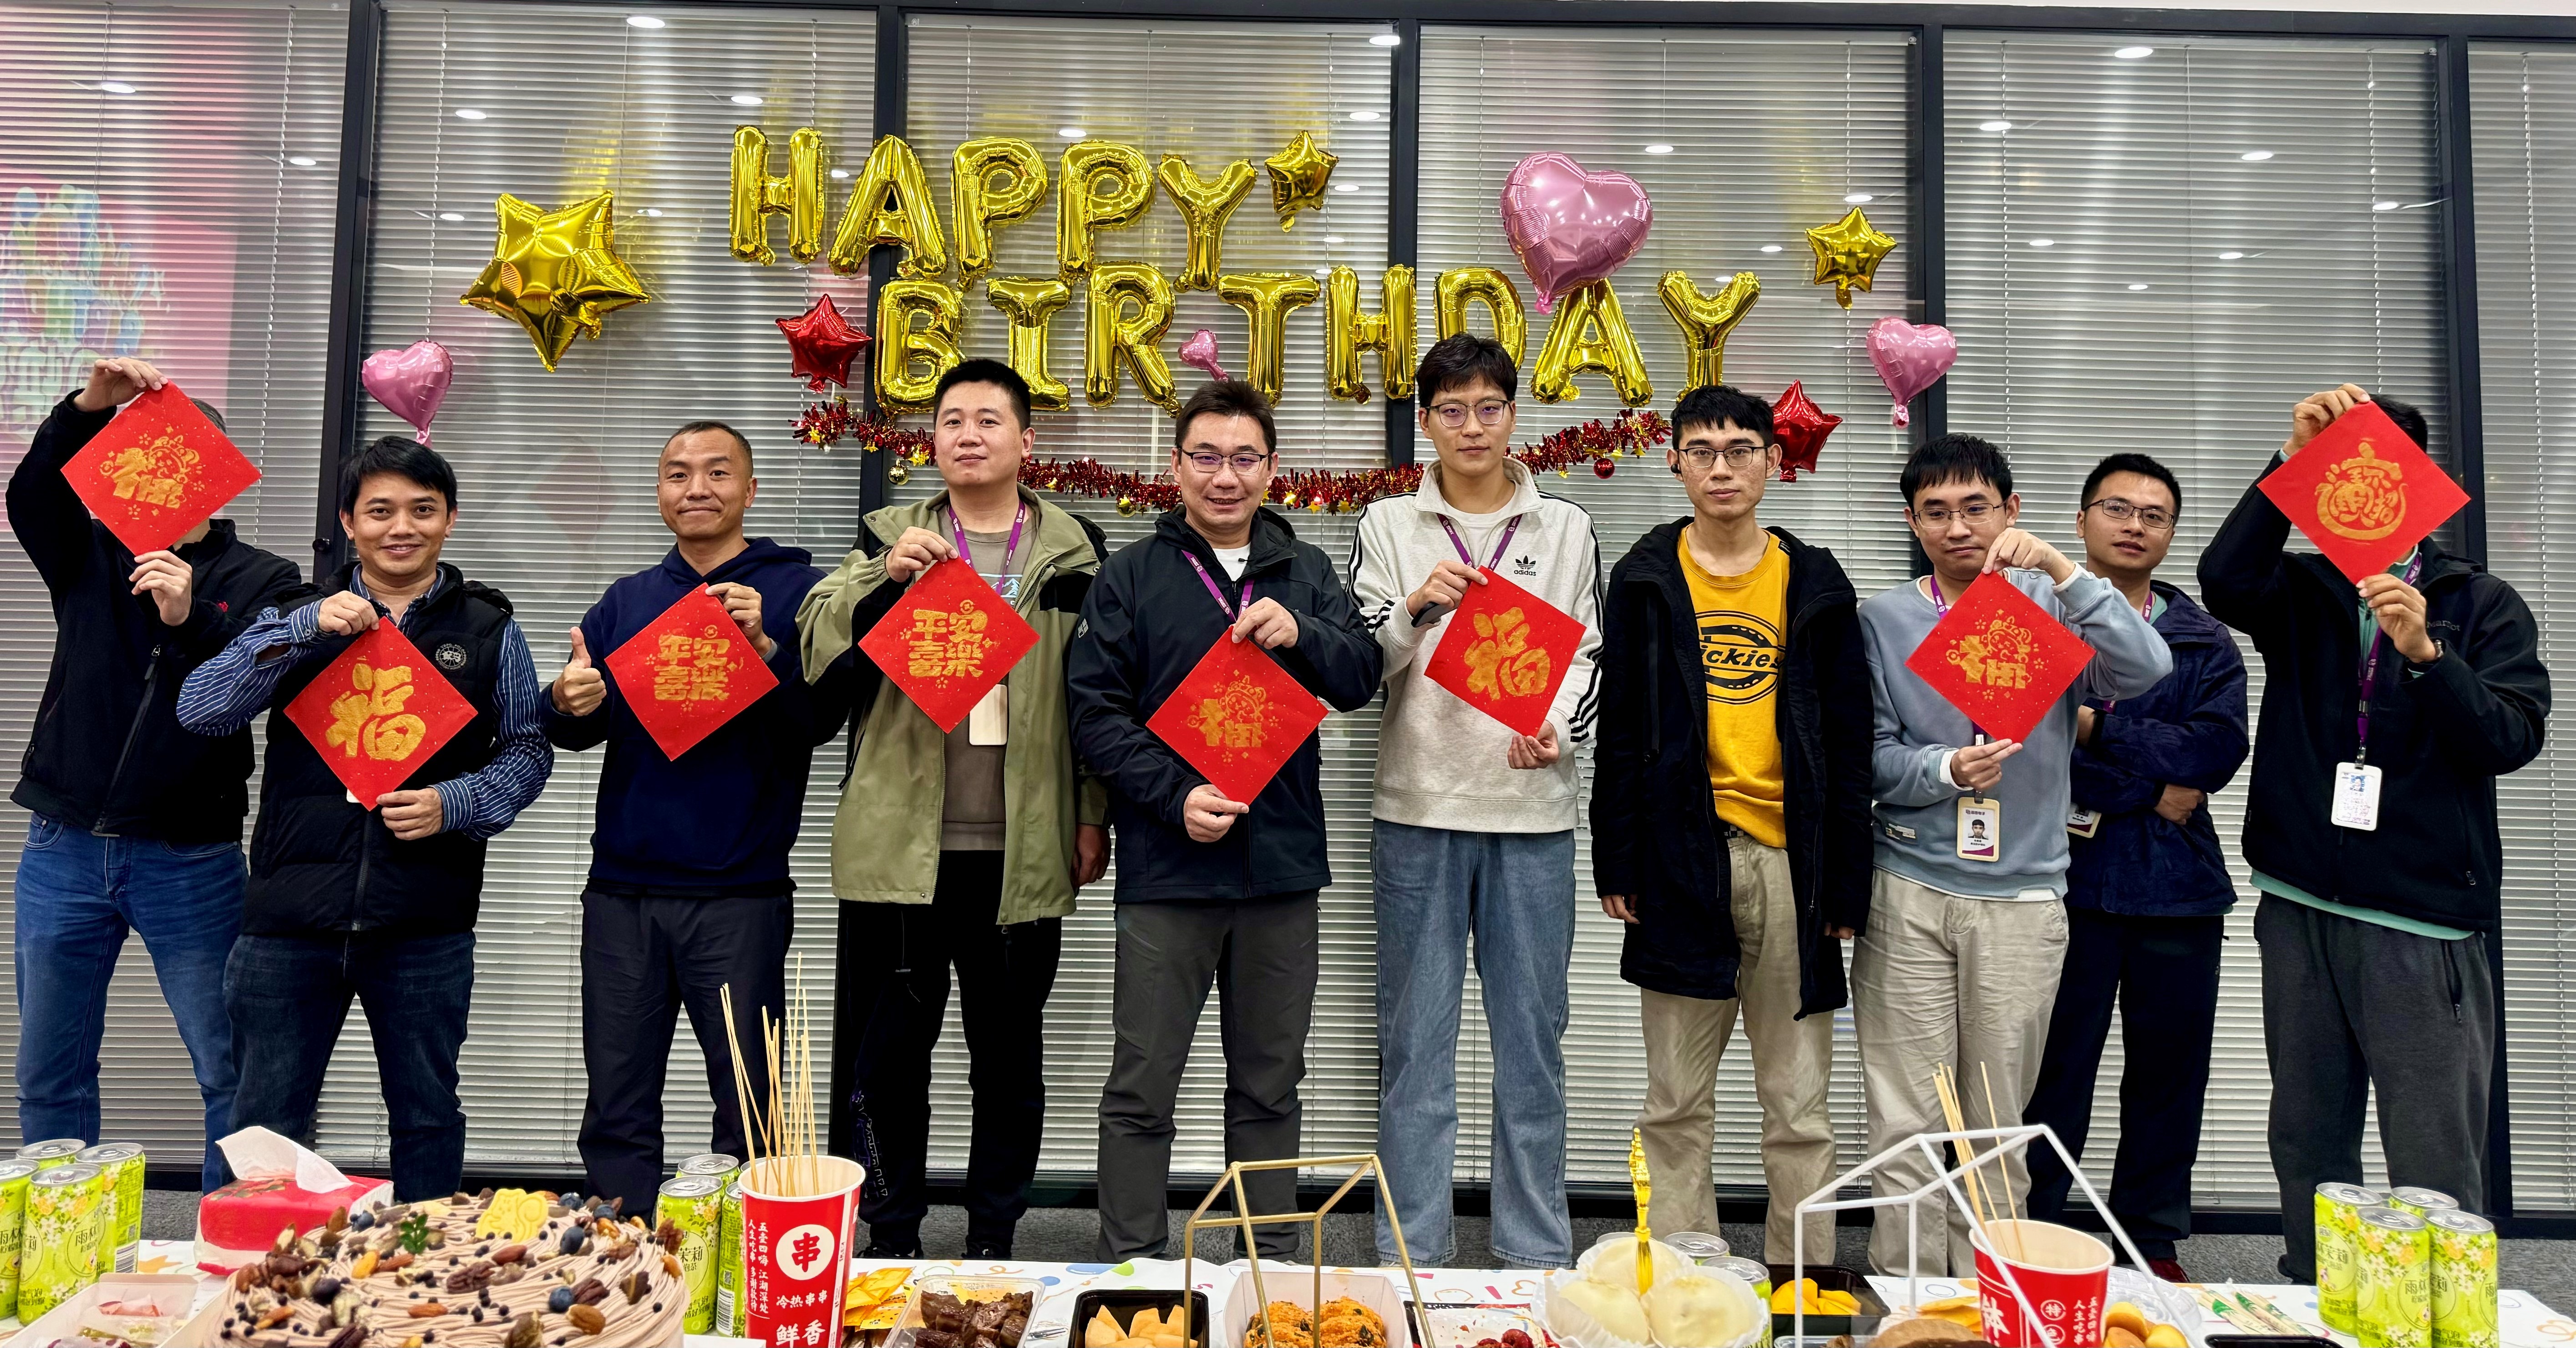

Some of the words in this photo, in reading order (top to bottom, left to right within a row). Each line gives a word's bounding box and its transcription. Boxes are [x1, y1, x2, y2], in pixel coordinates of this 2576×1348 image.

[729, 125, 1257, 290] HAPPY
[874, 261, 1760, 418] BIRTHDAY
[912, 609, 988, 643] 平安
[658, 634, 730, 667] 平安
[1464, 607, 1550, 700] 福
[1701, 645, 1779, 669] ickies
[325, 663, 426, 762] 福
[791, 1232, 821, 1272] 串
[776, 1289, 827, 1309] 冷热串串
[776, 1319, 826, 1348] 鲜香
